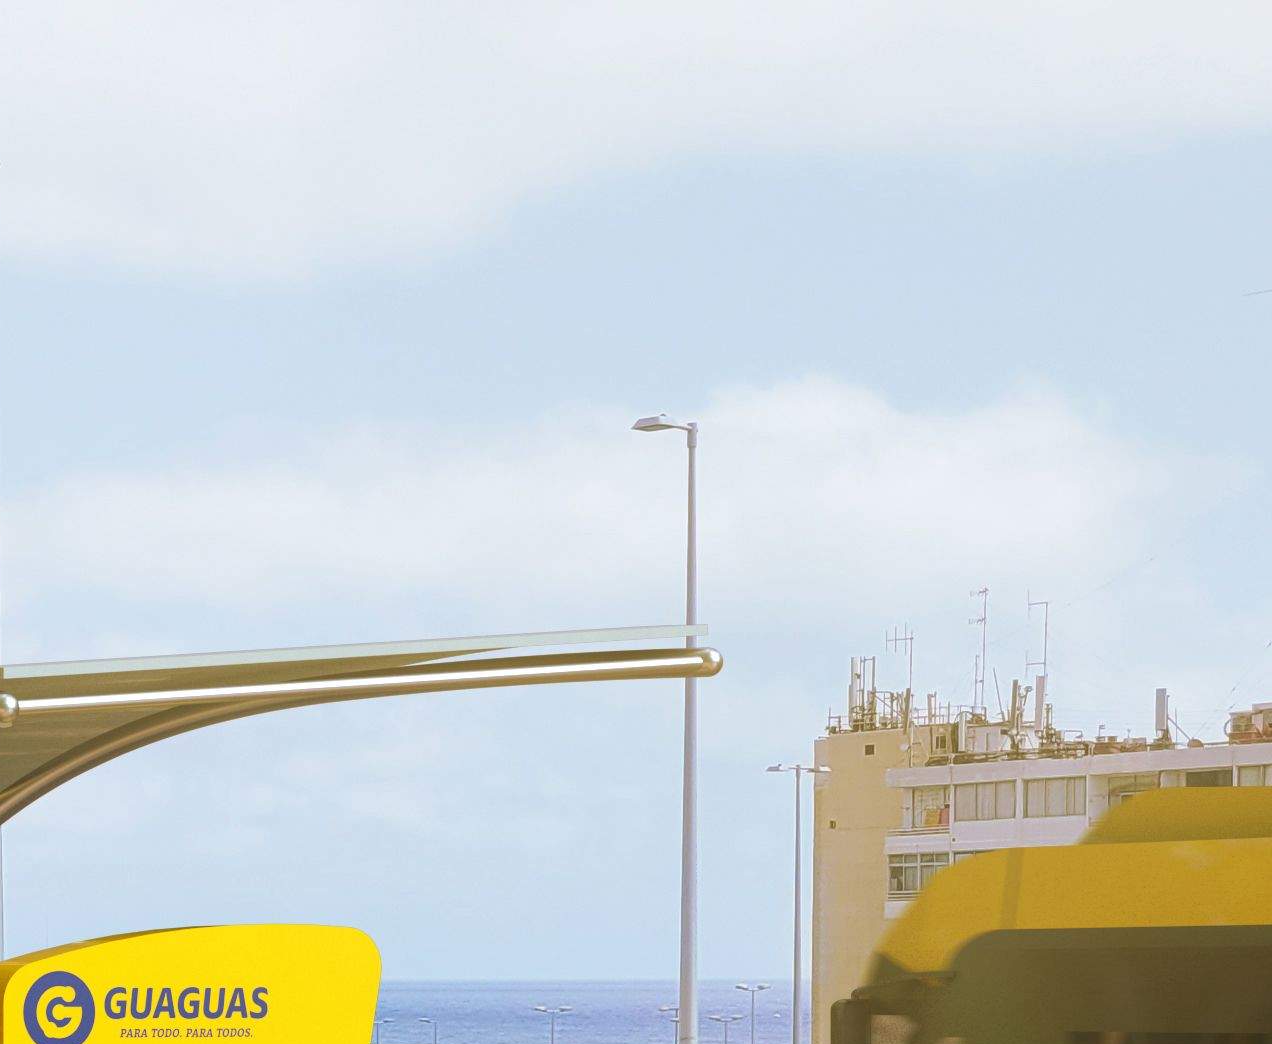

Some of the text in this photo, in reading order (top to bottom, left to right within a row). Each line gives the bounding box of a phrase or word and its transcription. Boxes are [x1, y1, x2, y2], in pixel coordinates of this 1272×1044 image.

[104, 986, 269, 1020] GUAGUAS
[120, 1028, 254, 1038] PARA TODO. PARA TODOS.
